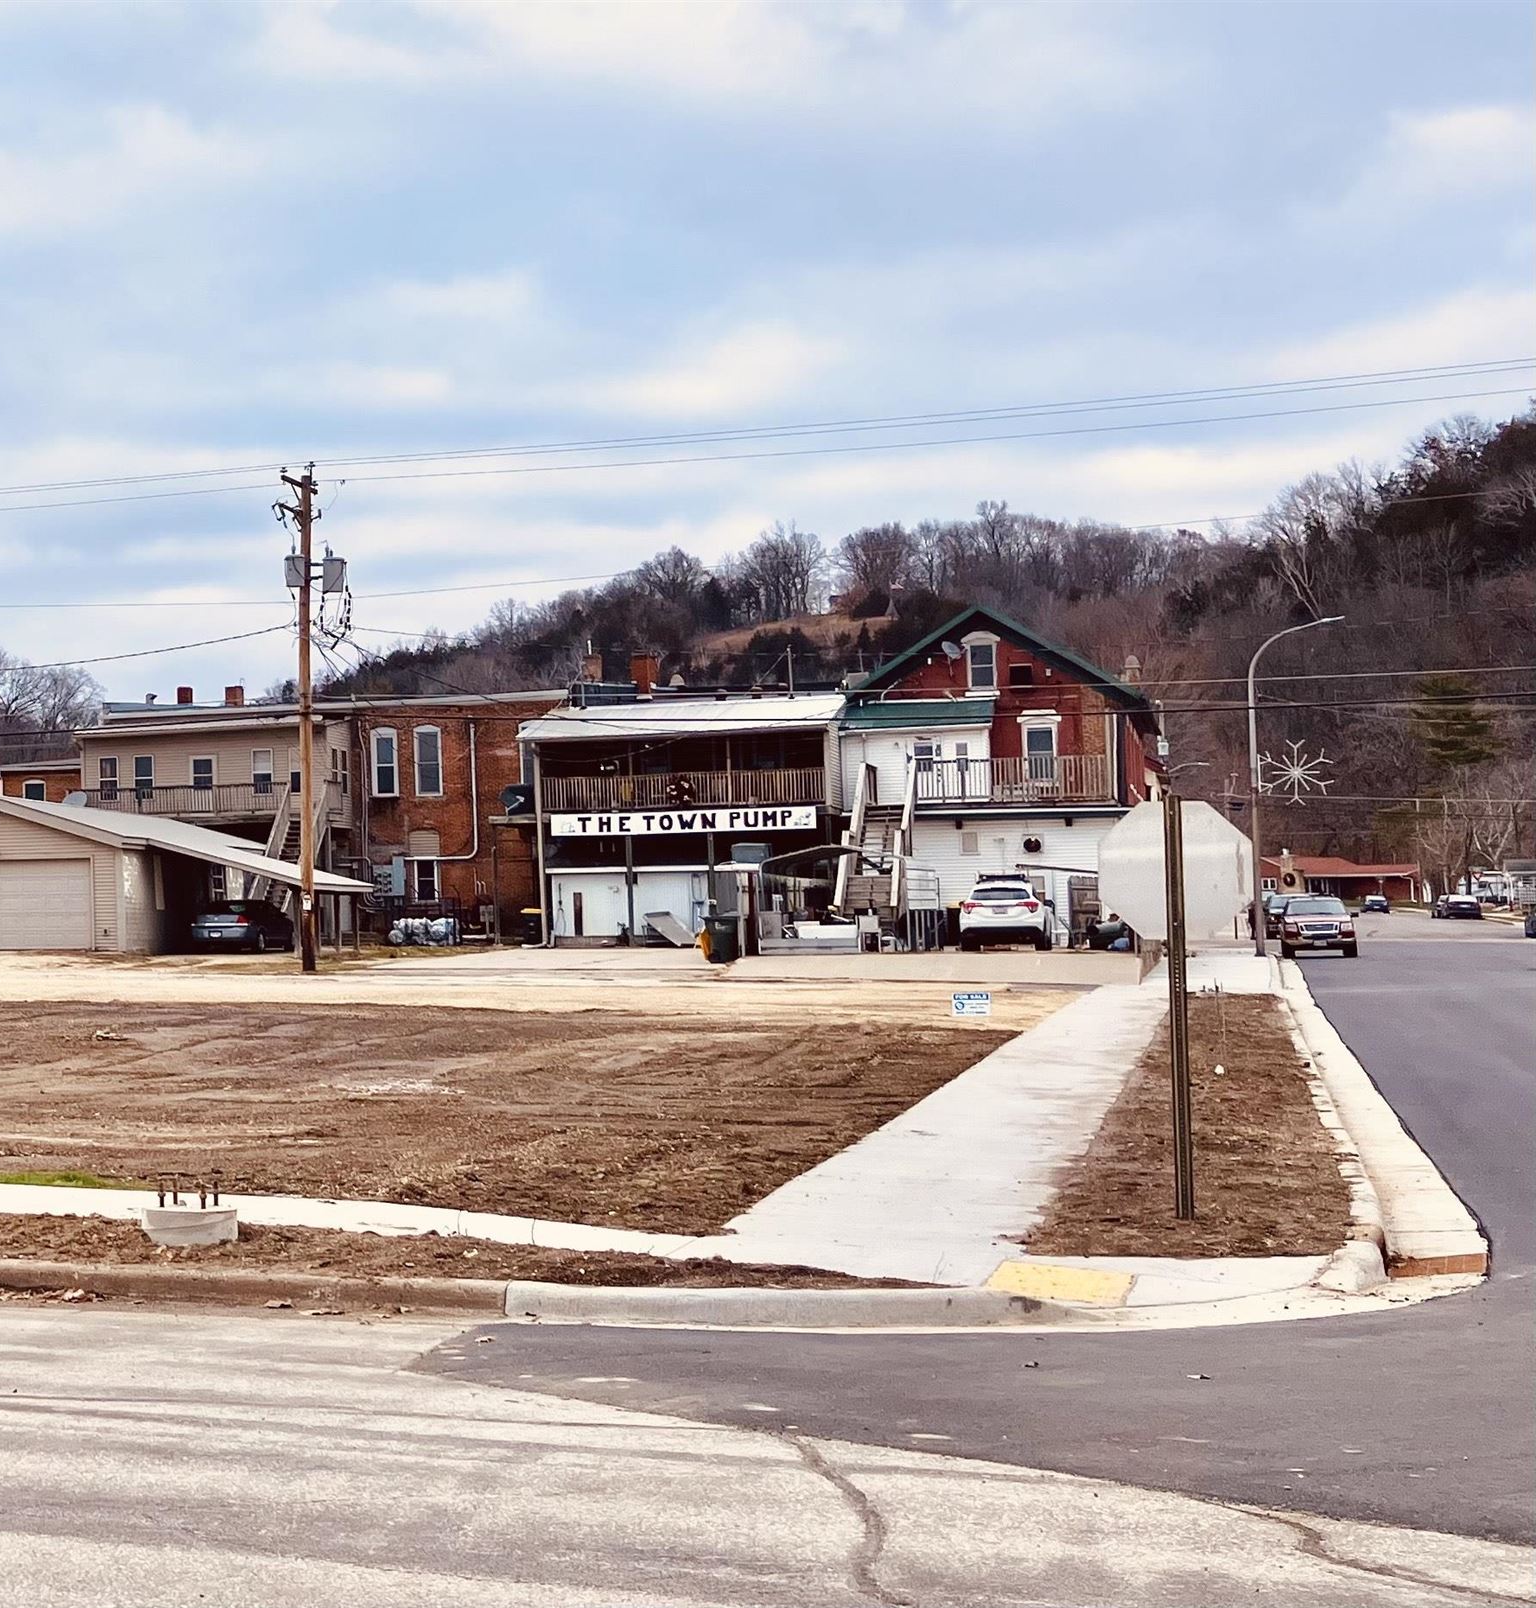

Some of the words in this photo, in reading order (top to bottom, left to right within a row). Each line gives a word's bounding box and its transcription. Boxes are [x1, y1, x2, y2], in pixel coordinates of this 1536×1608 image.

[577, 816, 632, 833] THE
[642, 812, 717, 832] TOWN
[728, 809, 793, 829] PUMP
